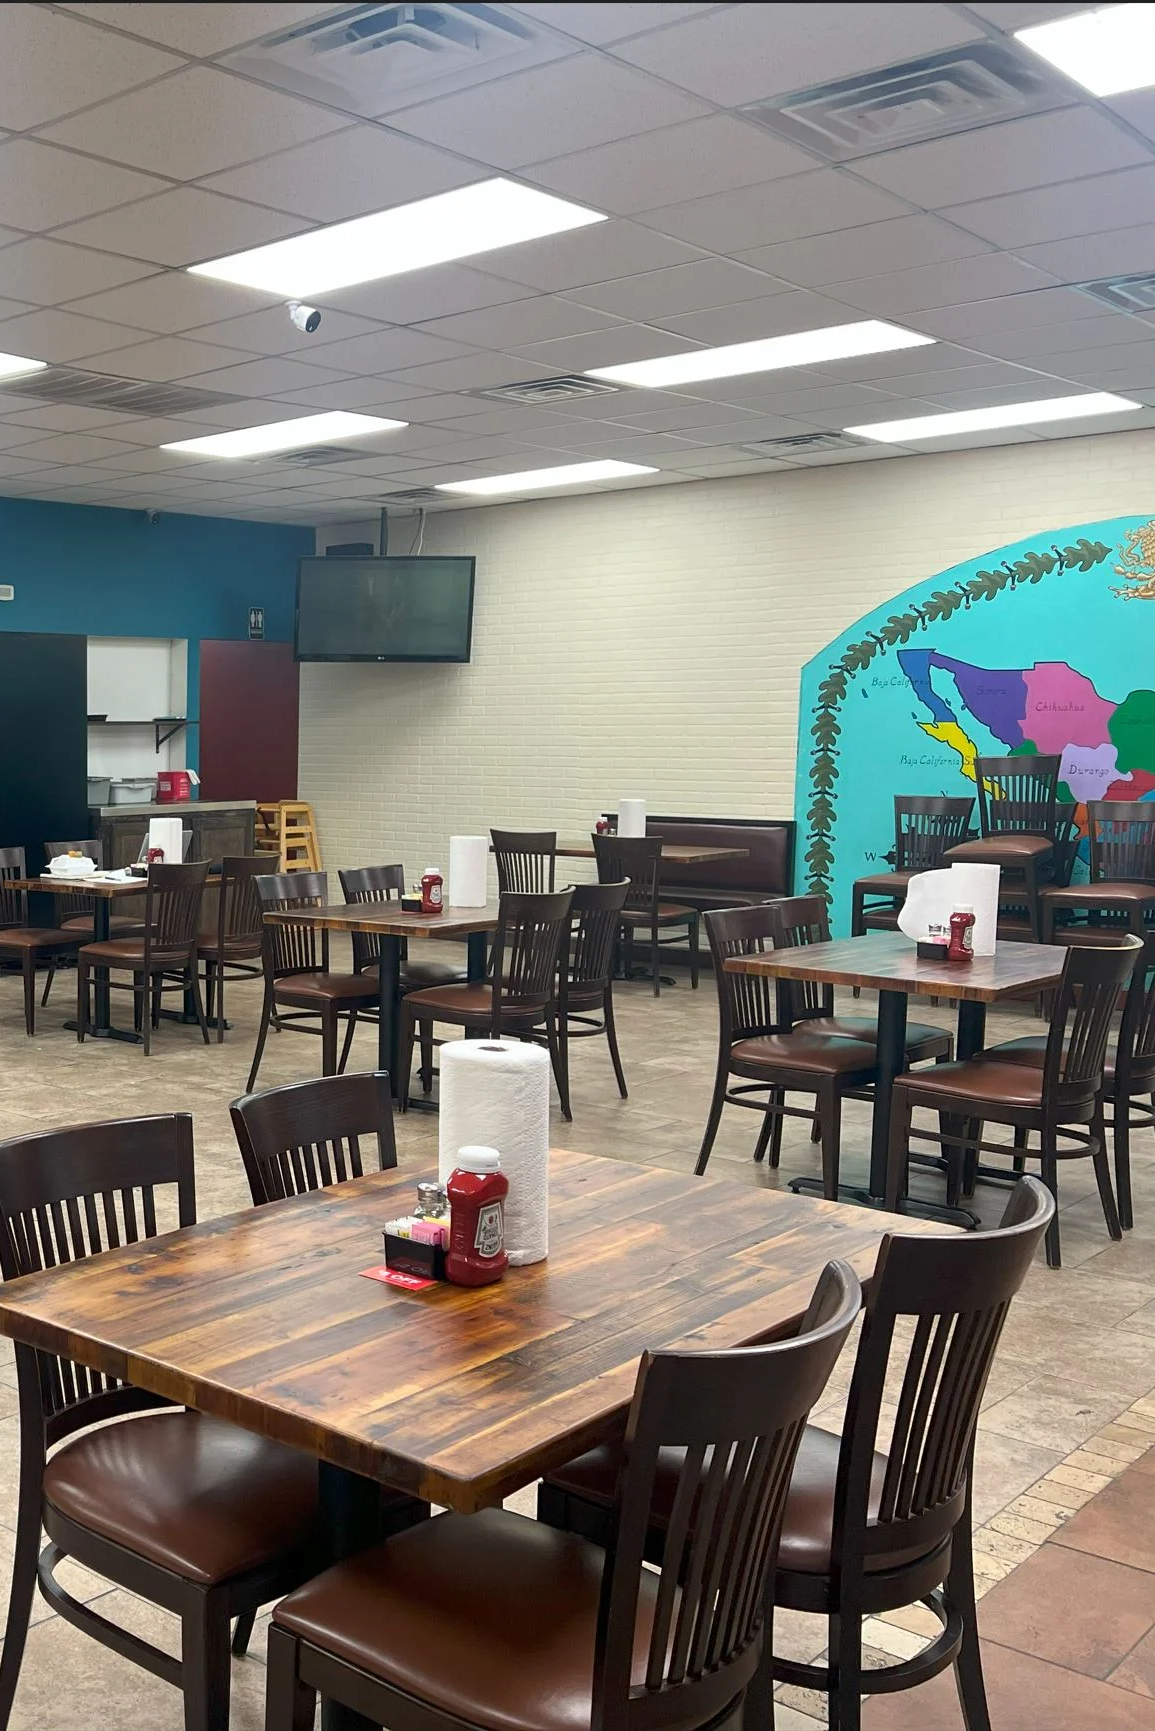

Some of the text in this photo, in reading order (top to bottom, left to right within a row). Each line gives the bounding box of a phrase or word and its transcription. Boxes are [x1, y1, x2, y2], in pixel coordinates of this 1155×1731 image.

[871, 677, 889, 688] Baja
[976, 685, 1007, 696] Sonora
[1035, 702, 1085, 713] Chihuahua
[900, 754, 975, 767] Baja California Su
[1068, 764, 1110, 778] Durango
[865, 852, 876, 861] W
